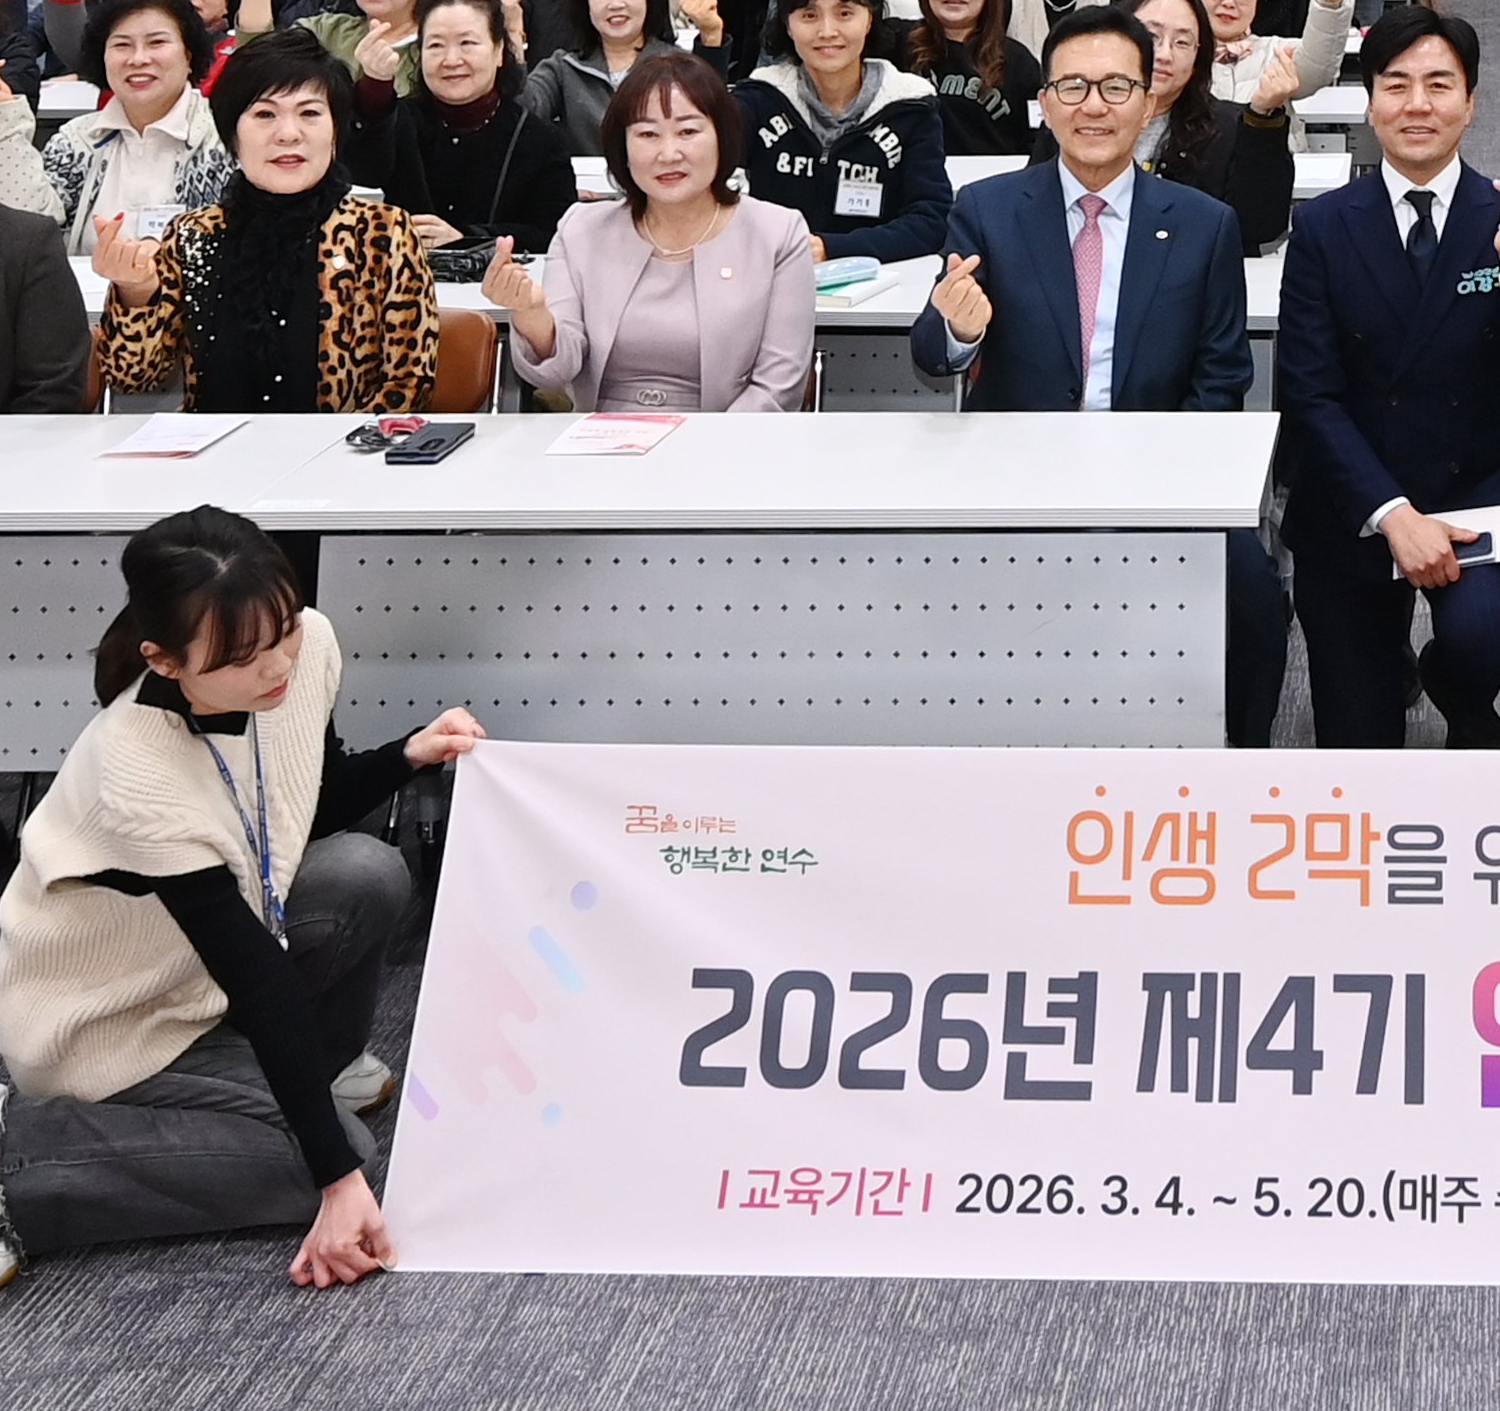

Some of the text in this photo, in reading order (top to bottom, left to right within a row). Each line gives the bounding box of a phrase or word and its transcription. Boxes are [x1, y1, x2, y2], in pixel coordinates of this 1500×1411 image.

[625, 804, 737, 835] 꿈을 이루는
[659, 844, 819, 876] 행복한 연수
[1067, 805, 1217, 906] 인생
[1248, 805, 1448, 908] 2막을
[678, 967, 1099, 1102] 2026년
[1135, 971, 1426, 1106] 제4기
[954, 1172, 1086, 1216] 2026.
[1100, 1174, 1140, 1216] 3.
[1154, 1175, 1196, 1217] 4.
[1253, 1176, 1292, 1218] 5.
